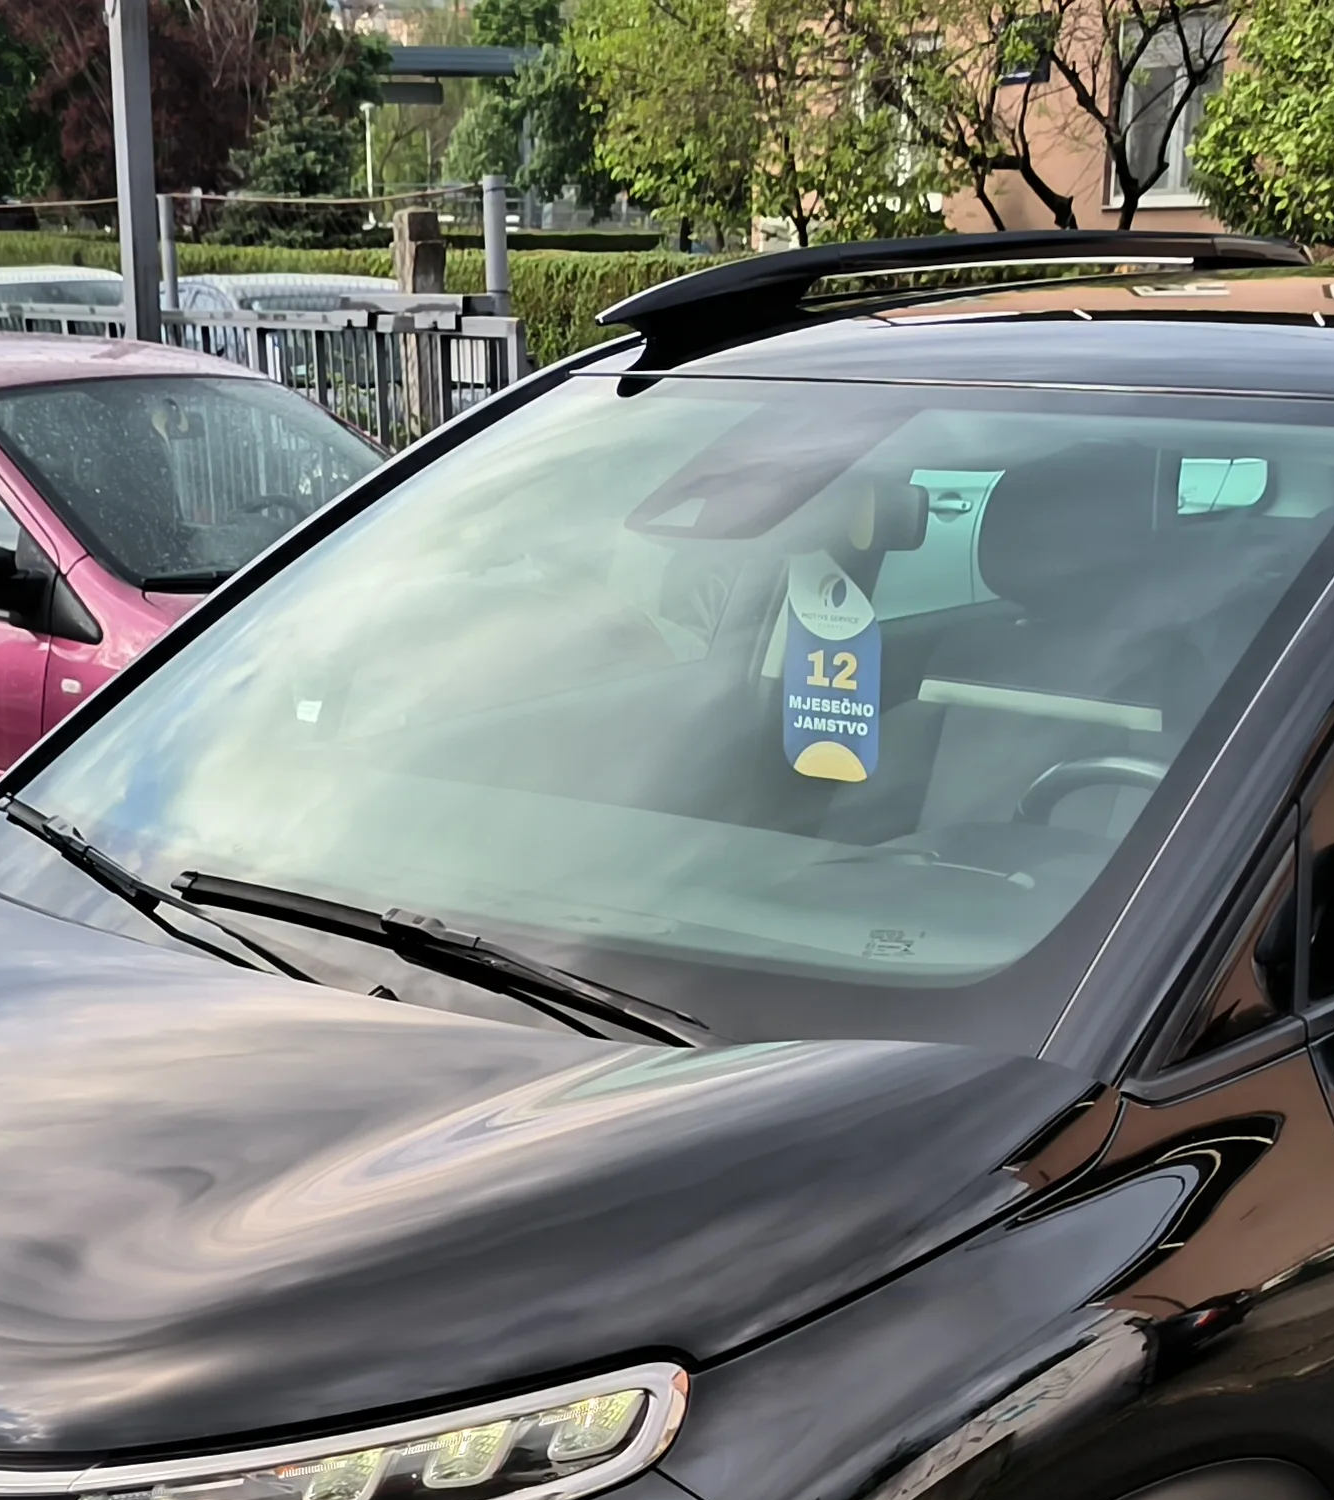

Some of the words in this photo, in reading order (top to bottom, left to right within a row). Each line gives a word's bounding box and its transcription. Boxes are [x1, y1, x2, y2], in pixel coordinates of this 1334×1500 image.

[806, 649, 858, 691] 12
[788, 694, 874, 718] MJESEČNO
[793, 715, 868, 736] JAMSTVO
